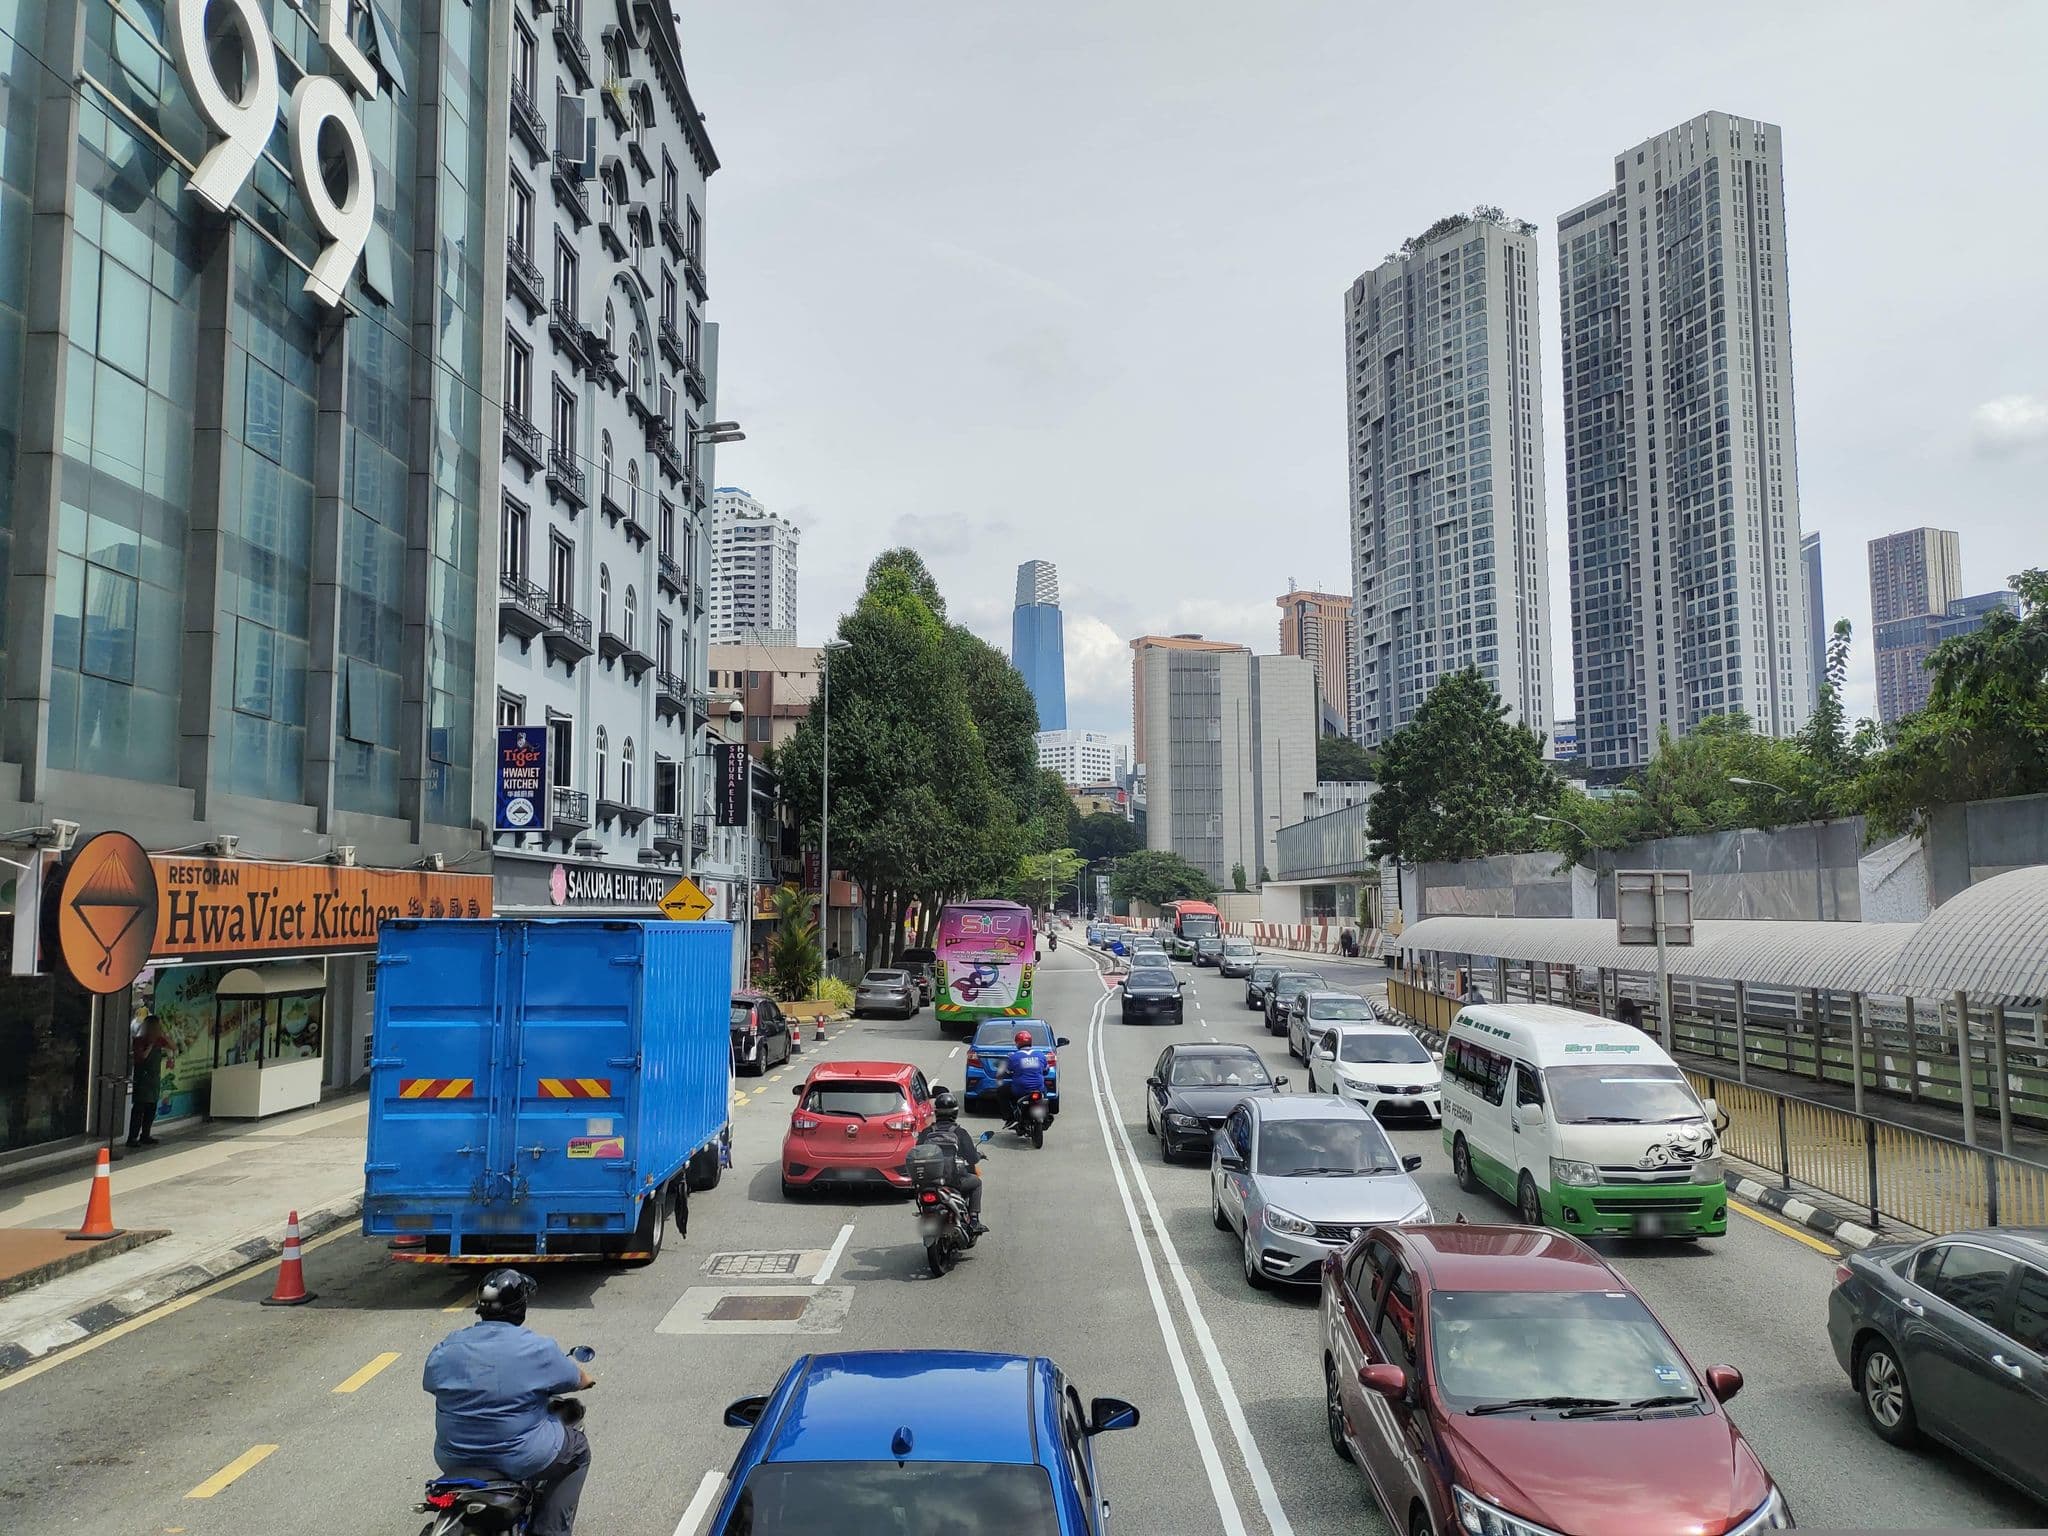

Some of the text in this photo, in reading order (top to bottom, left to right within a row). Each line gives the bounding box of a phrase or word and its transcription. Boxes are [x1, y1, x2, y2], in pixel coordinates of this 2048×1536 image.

[503, 748, 540, 767] Tiger
[502, 767, 540, 778] HWAVIET
[503, 778, 539, 790] KITCHEN
[169, 866, 239, 886] RESTORAN
[568, 870, 613, 899] SAKURA
[615, 874, 639, 900] ELITE
[165, 886, 306, 945] HwaViet
